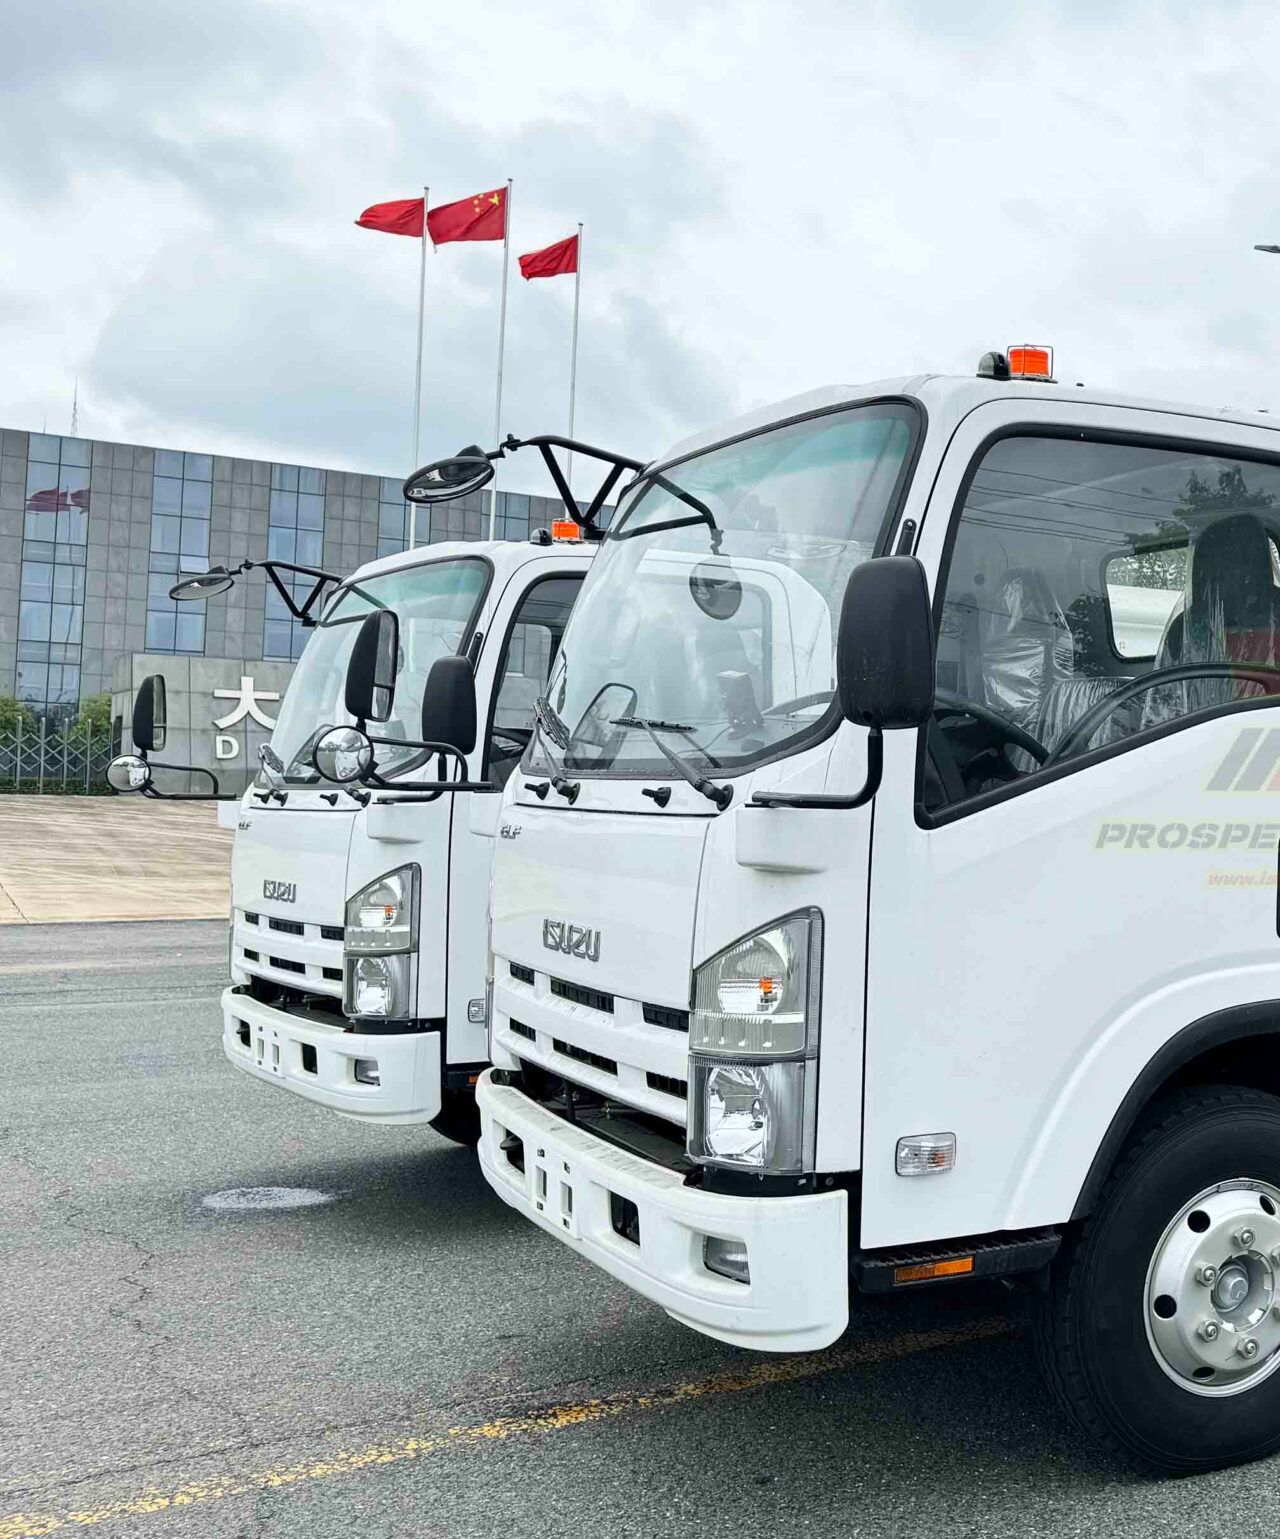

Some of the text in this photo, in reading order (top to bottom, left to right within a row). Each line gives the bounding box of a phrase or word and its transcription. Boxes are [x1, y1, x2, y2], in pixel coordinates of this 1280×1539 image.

[212, 676, 280, 731] 大
[263, 879, 297, 903] ISUZU
[543, 919, 600, 962] ISUZU
